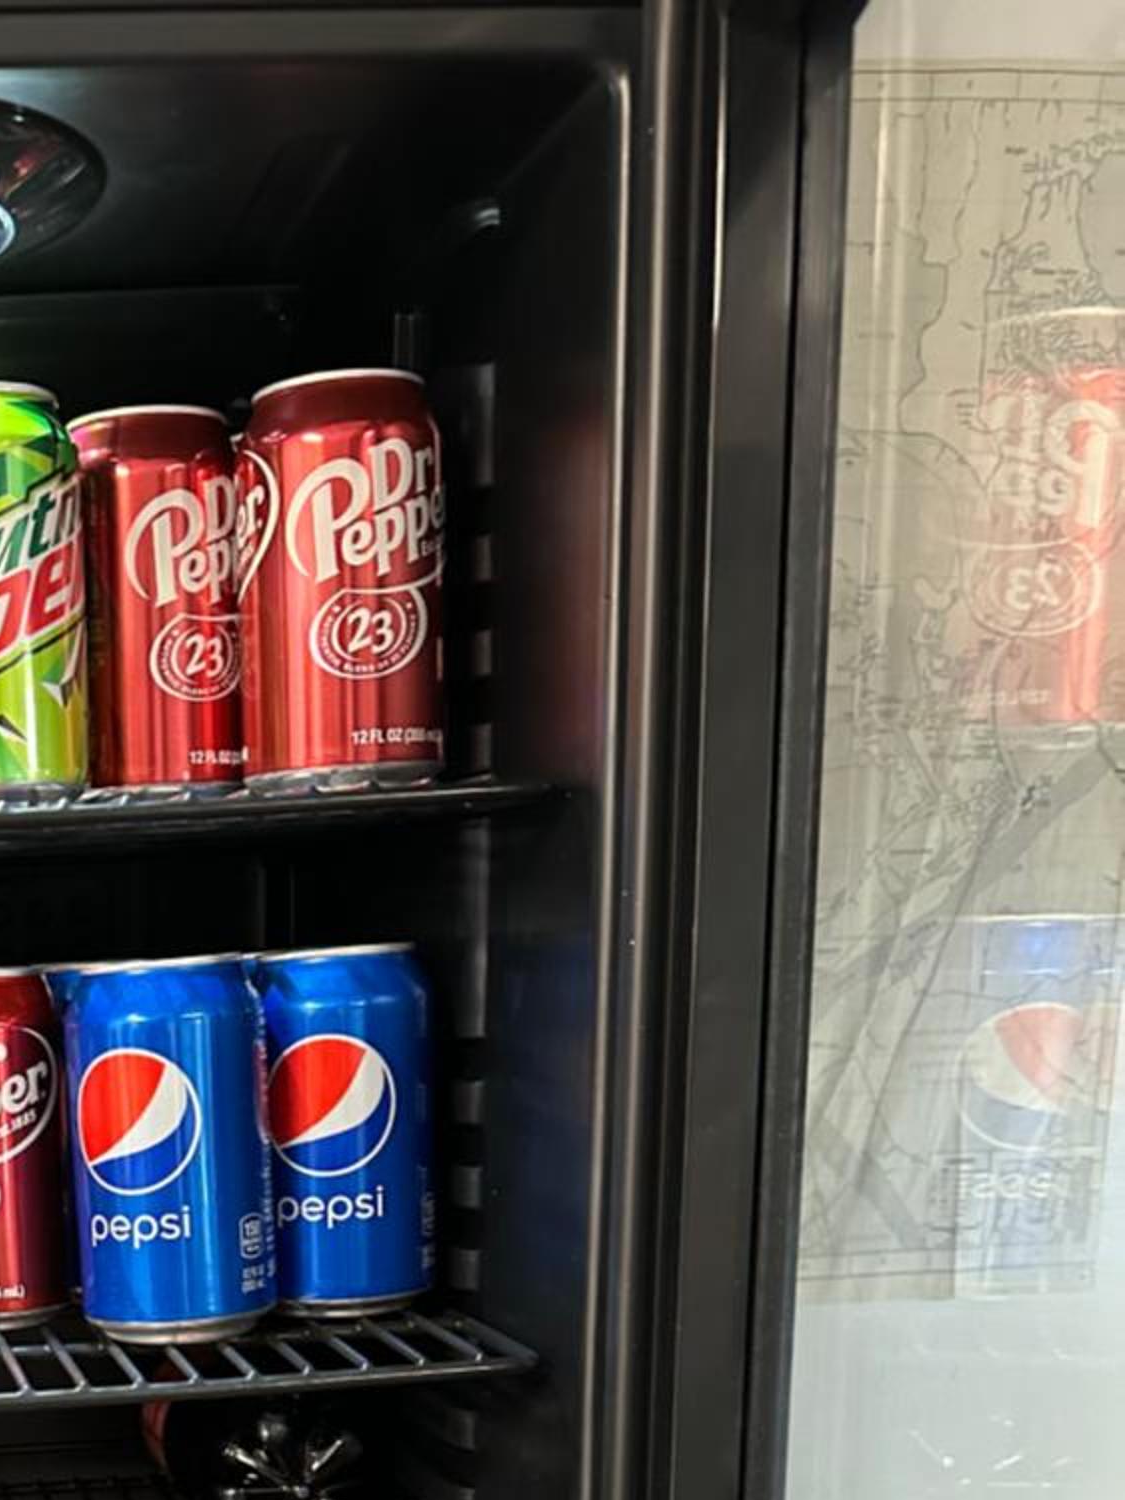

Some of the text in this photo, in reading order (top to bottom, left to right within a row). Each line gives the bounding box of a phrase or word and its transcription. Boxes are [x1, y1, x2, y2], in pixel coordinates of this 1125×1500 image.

[368, 437, 434, 513] Dr
[285, 456, 444, 584] Peppe
[346, 606, 394, 655] 23
[184, 632, 223, 678] 23
[92, 1206, 192, 1249] pepsi
[277, 1186, 385, 1228] pepsi
